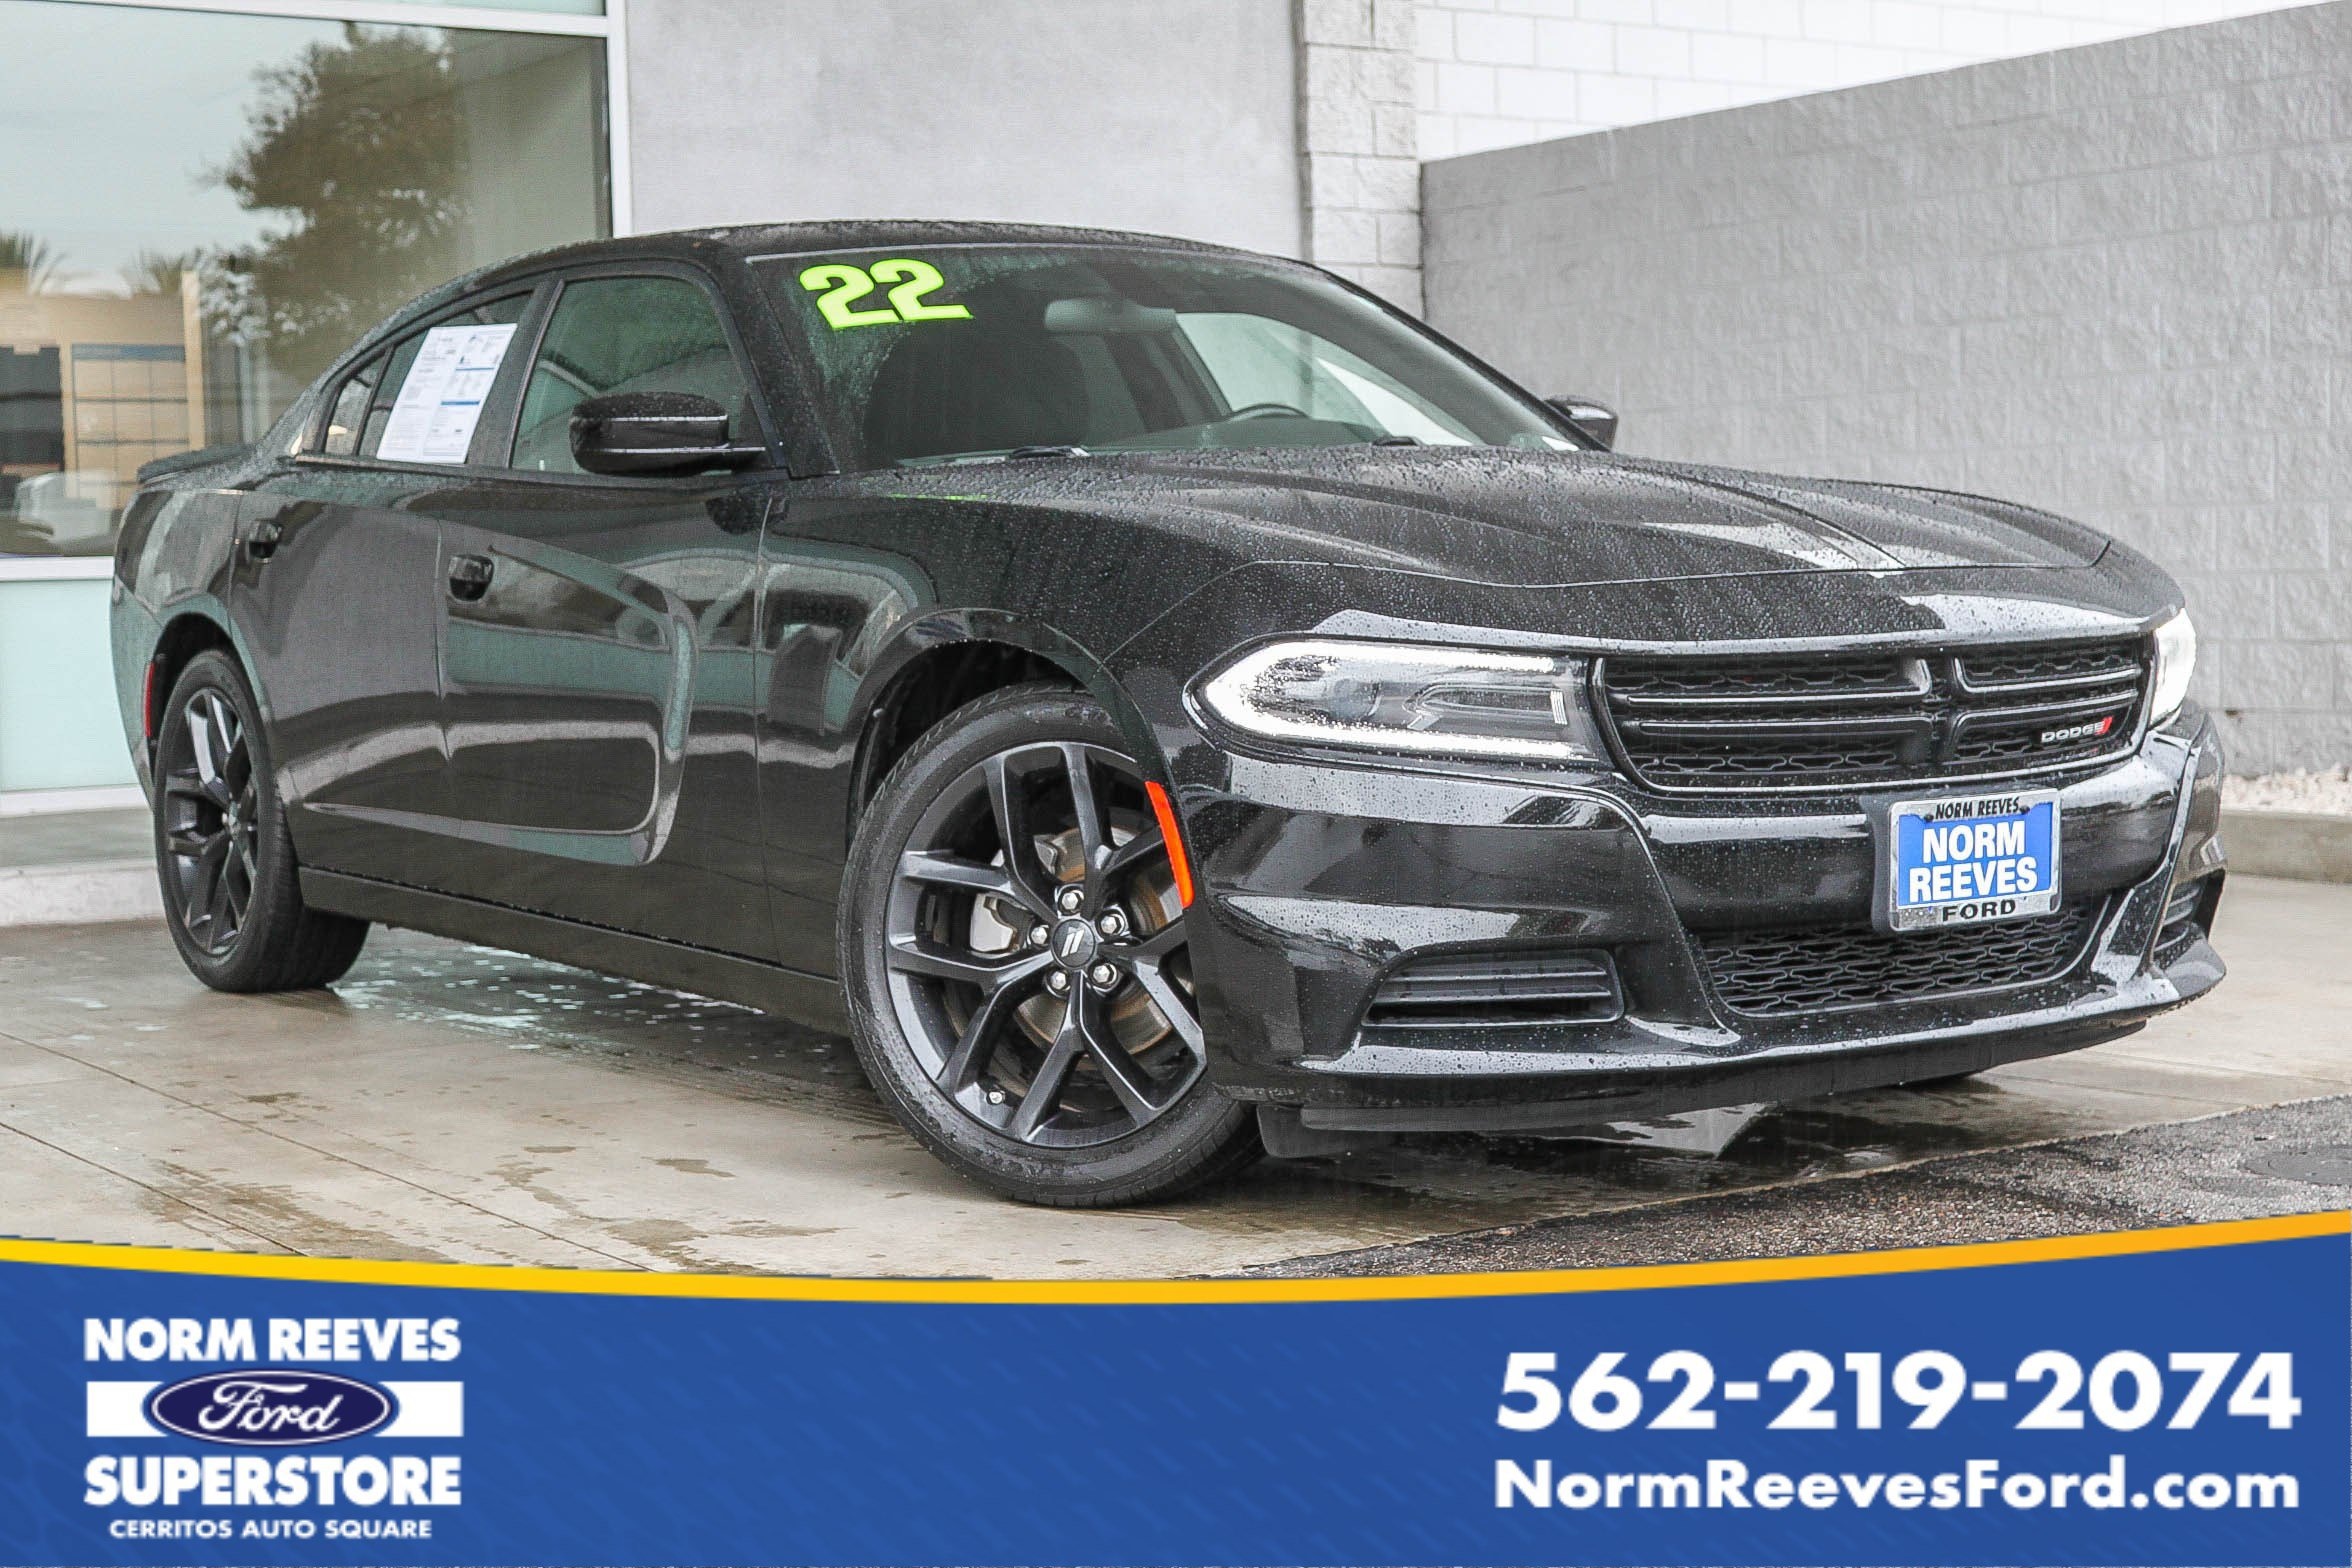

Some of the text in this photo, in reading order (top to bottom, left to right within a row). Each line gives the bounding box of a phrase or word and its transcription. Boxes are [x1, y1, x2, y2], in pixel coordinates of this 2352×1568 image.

[800, 258, 975, 330] 22
[2041, 721, 2105, 743] DODGE
[1935, 797, 2020, 820] NORM REEVES
[1923, 820, 2025, 863] NORM
[1909, 856, 2038, 903] REEVES
[1942, 899, 2016, 922] FORD
